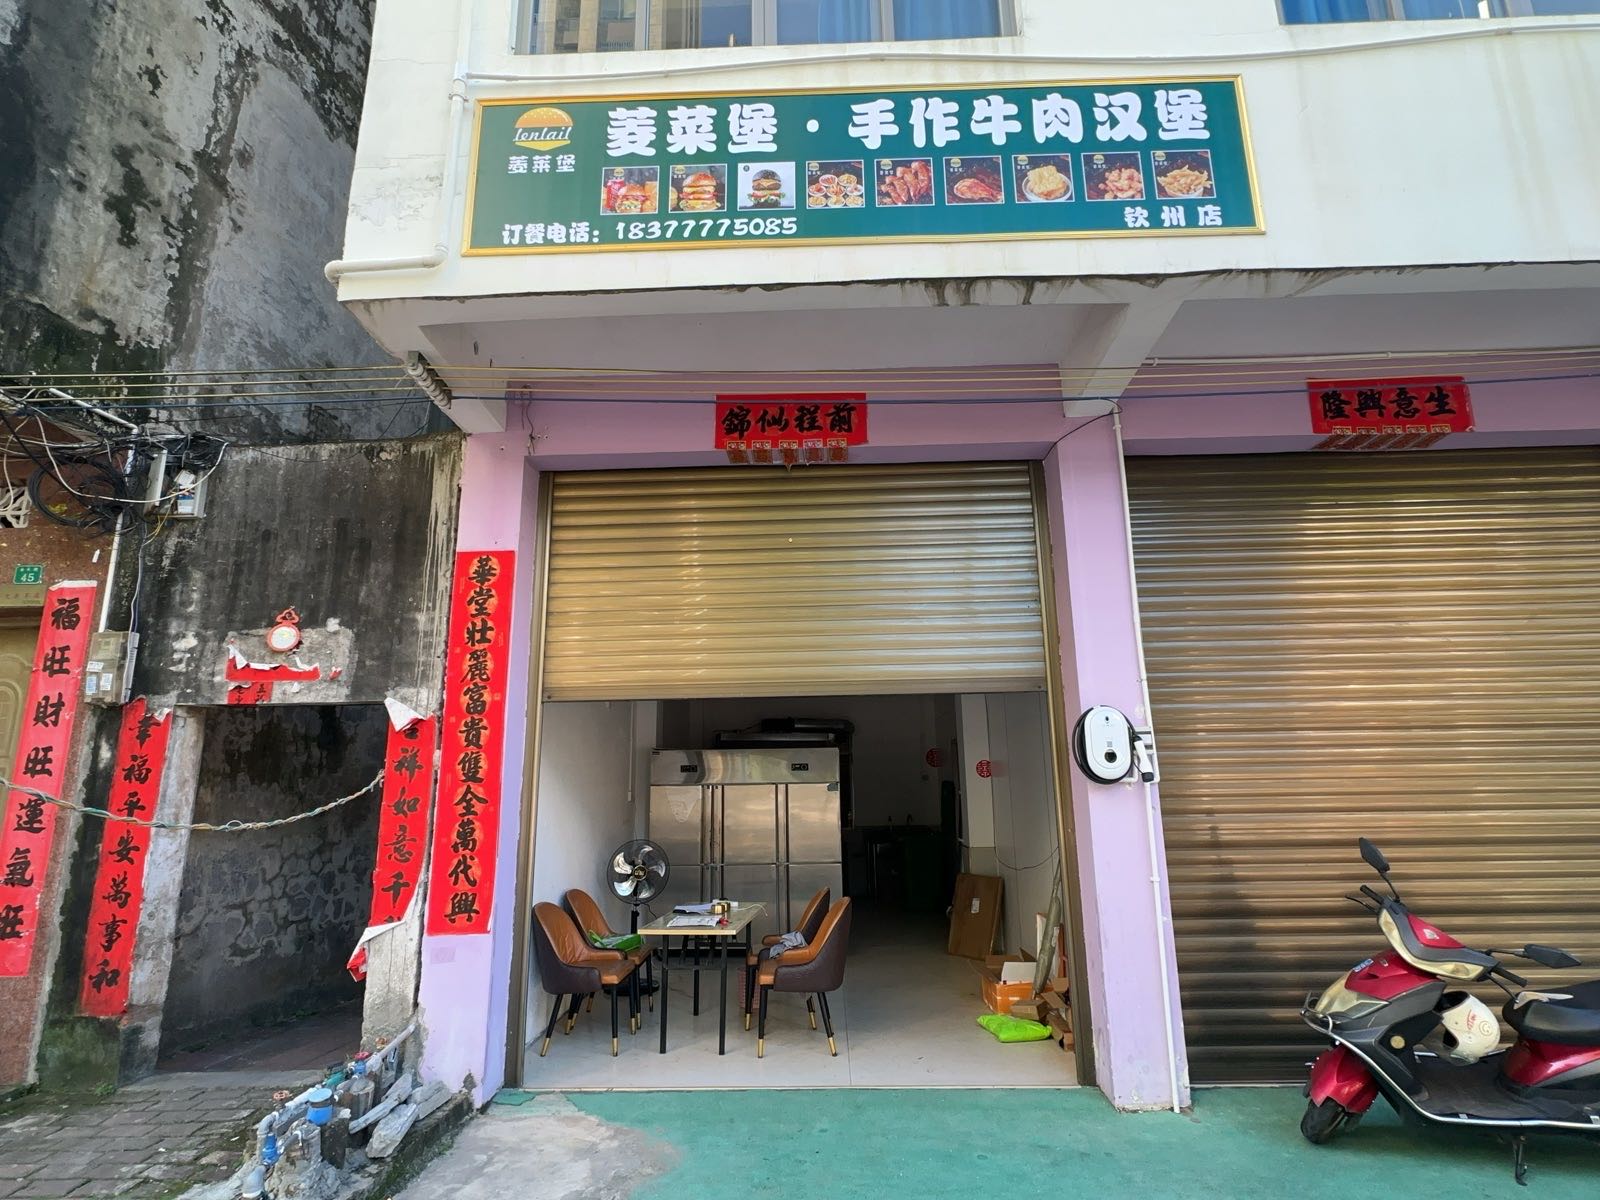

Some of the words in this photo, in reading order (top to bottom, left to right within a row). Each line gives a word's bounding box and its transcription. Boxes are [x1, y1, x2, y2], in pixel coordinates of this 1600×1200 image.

[1124, 204, 1223, 228] 钦州店
[615, 217, 798, 240] 18377775085
[20, 572, 36, 582] 45
